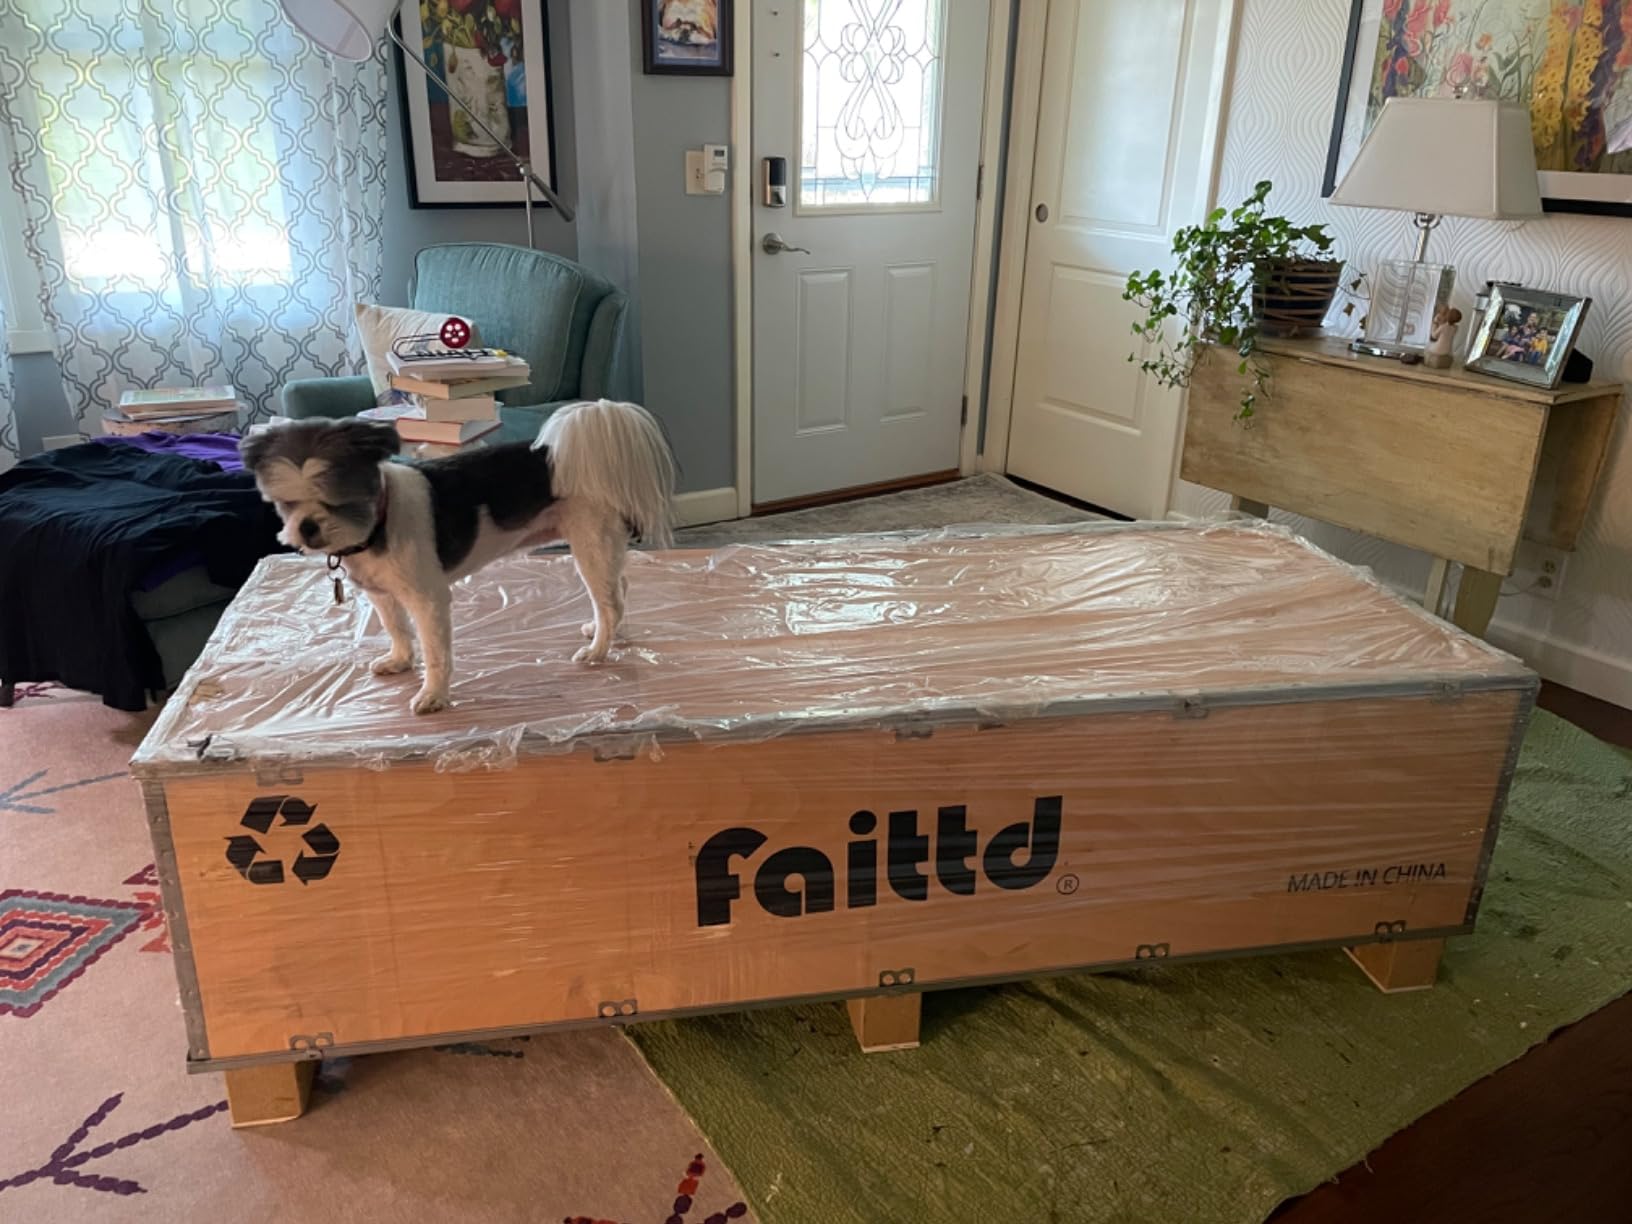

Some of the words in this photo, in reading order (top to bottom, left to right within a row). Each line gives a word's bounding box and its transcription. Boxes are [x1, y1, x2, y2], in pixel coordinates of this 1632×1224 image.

[695, 795, 1063, 928] faittd
[1287, 871, 1349, 892] MADE
[1353, 868, 1378, 888] IN
[1383, 863, 1446, 885] CHINA
